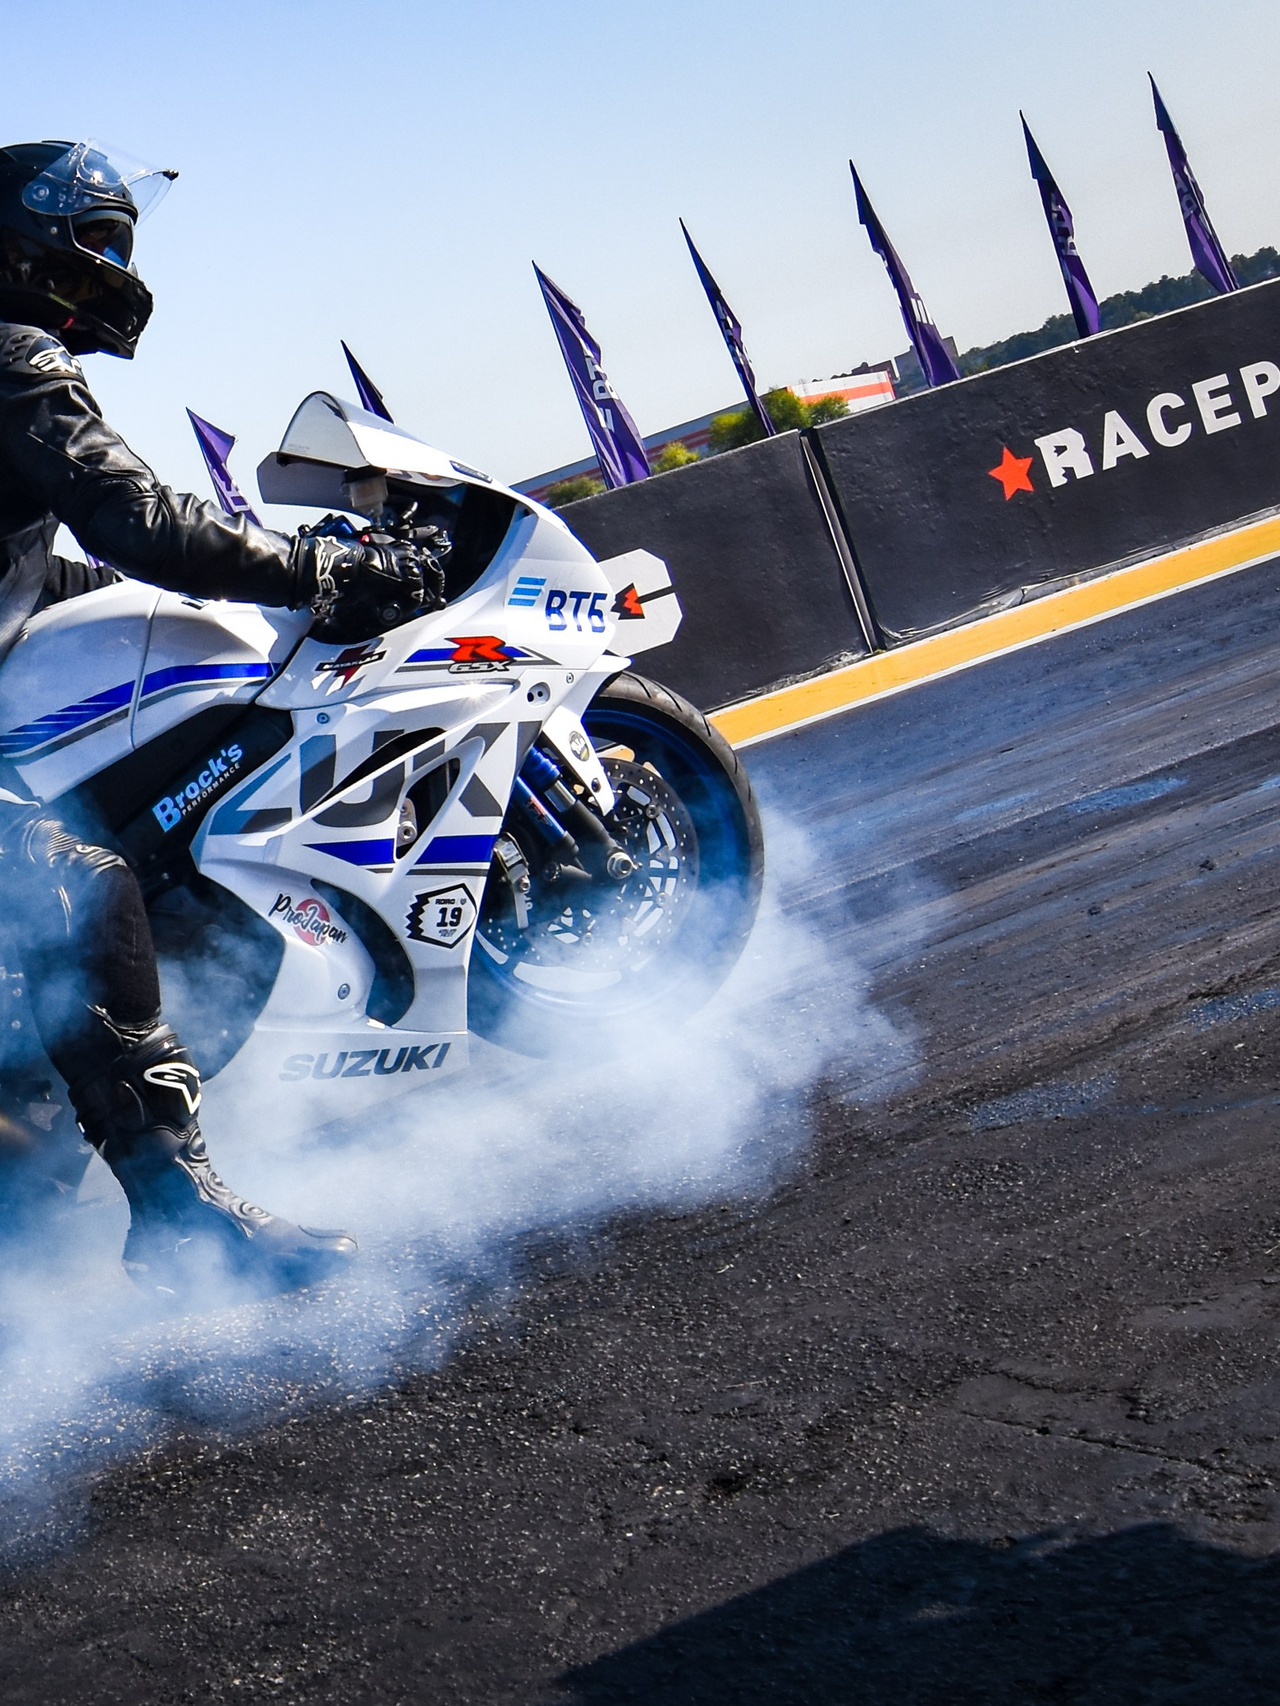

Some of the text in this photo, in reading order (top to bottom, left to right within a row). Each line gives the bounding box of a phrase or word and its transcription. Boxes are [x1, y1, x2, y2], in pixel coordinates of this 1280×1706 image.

[1034, 360, 1280, 488] RACEP
[448, 660, 511, 674] GSX
[152, 744, 243, 833] Brock's
[181, 761, 240, 816] PERFORMANCE
[436, 907, 463, 928] 19
[278, 1042, 452, 1082] SUZUKI
